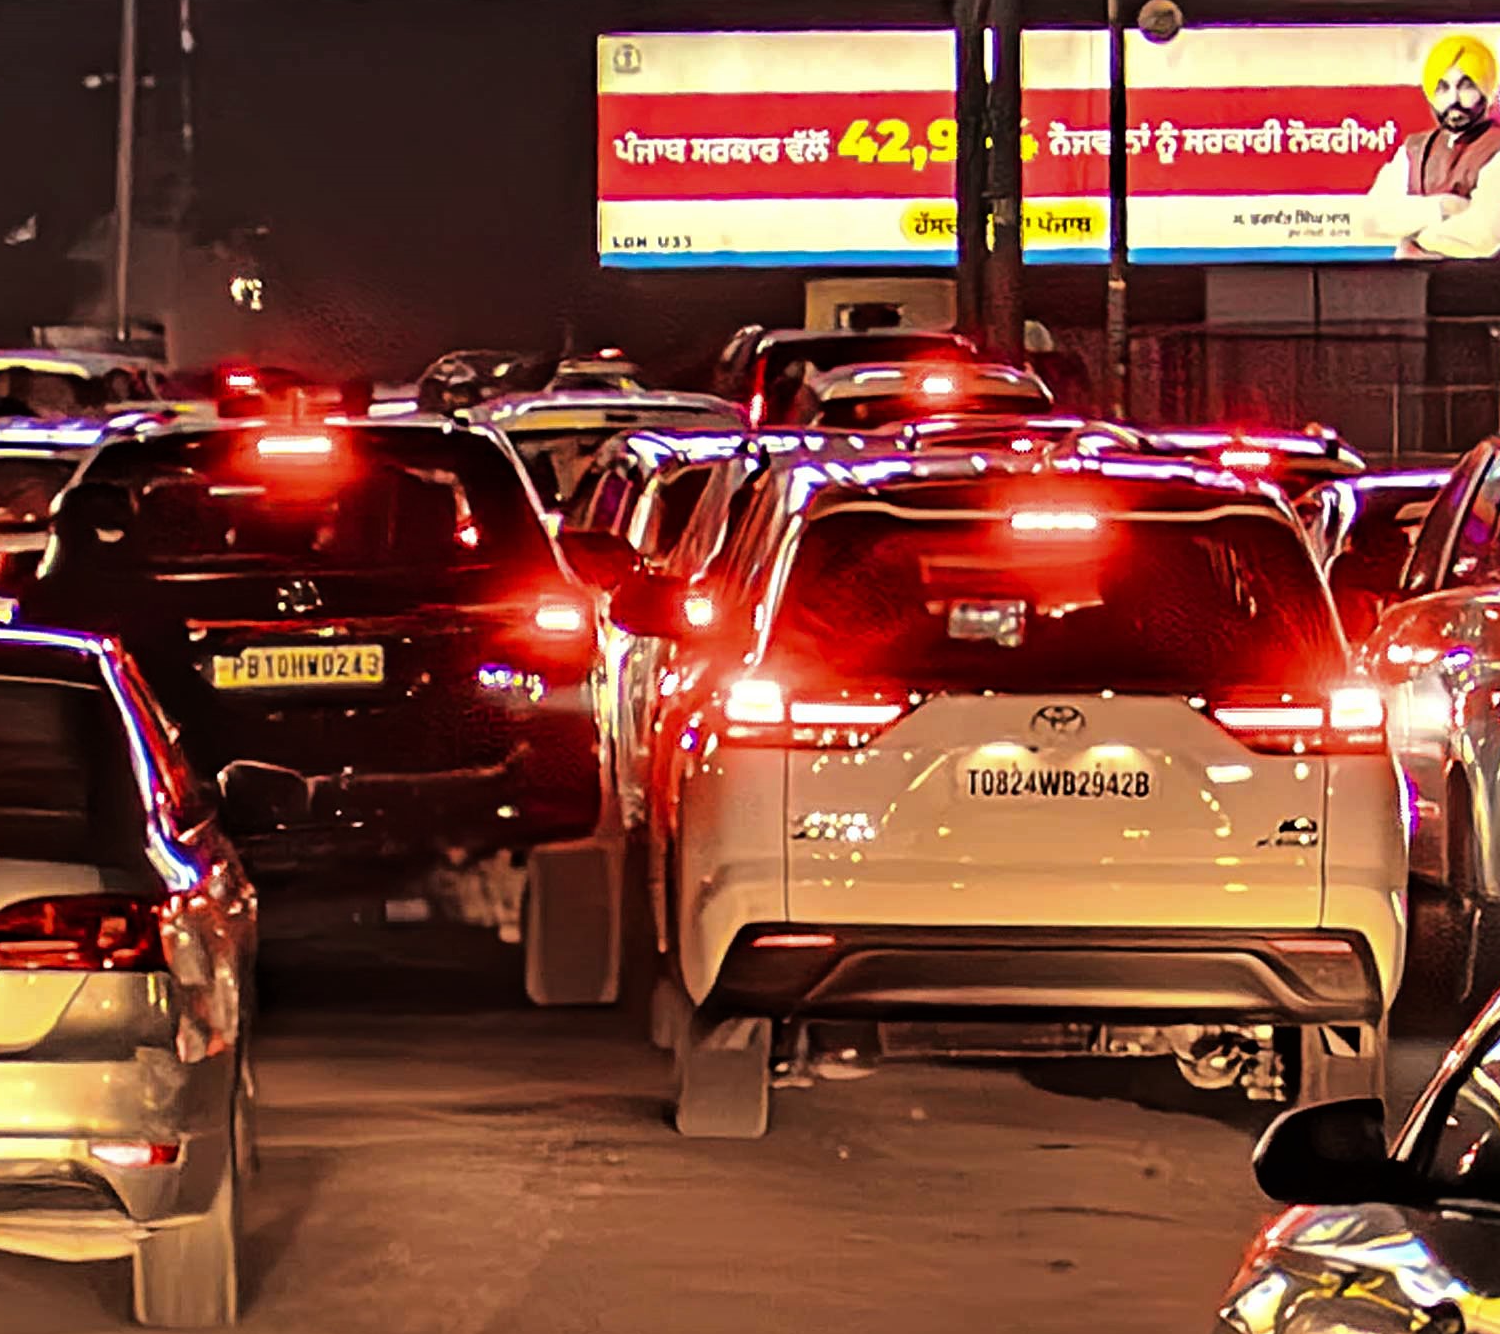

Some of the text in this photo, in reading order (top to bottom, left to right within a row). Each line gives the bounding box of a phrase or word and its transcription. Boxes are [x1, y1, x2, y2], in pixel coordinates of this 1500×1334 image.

[613, 130, 687, 164] ਪੰਜਾਬ
[690, 136, 782, 164] ਸਰਕਾਰ
[1182, 118, 1283, 155] ਸਰਕਾਰੀ
